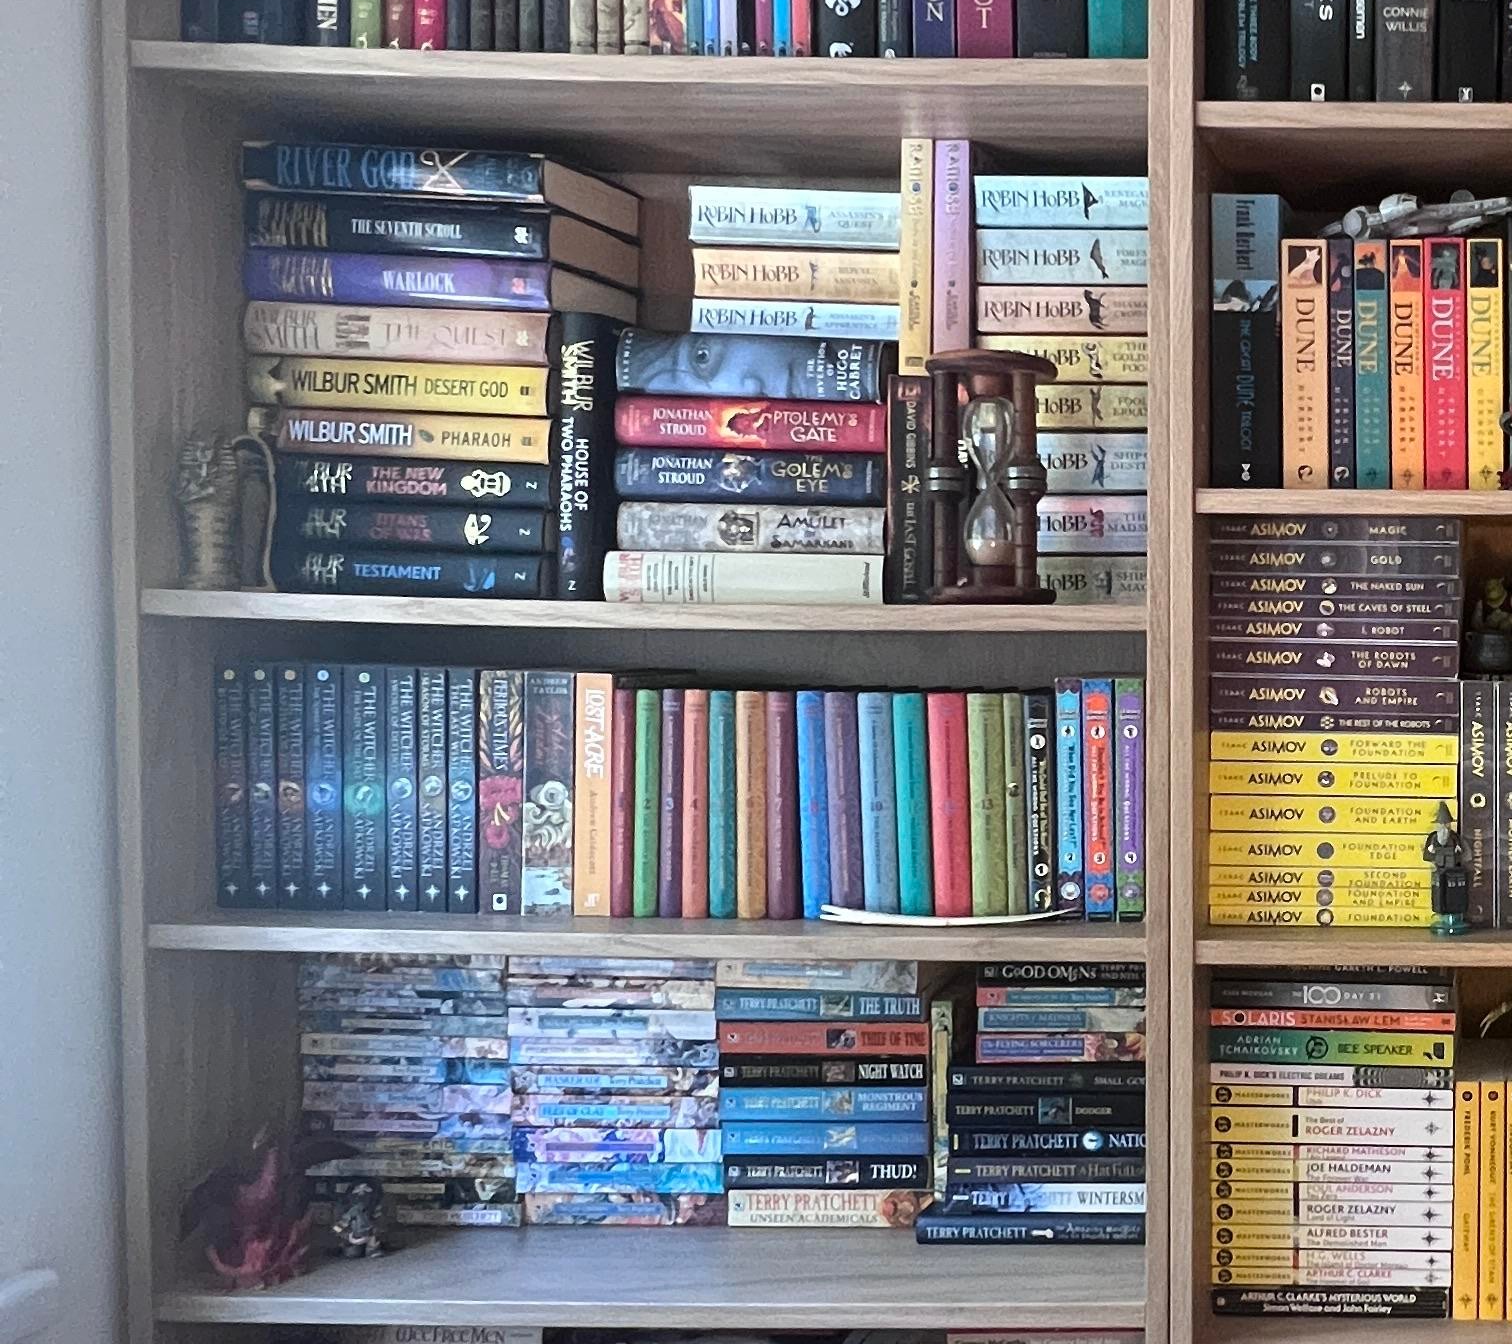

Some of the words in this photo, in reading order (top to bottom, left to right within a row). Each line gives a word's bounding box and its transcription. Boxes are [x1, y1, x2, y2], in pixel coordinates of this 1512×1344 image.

[1383, 7, 1428, 18] CONNIE
[1386, 22, 1427, 33] WILLIS
[277, 148, 352, 189] RIVER
[362, 149, 416, 189] GOD
[382, 270, 454, 293] WARLOCK
[1296, 298, 1314, 373] DUNE
[1432, 298, 1453, 381] DUNE
[837, 350, 848, 390] HUGO
[850, 345, 862, 400] CABRET
[291, 370, 359, 394] WILBUR
[364, 375, 417, 395] SMITH
[424, 378, 475, 395] DESERT
[479, 381, 508, 398] GOD
[790, 427, 838, 442] GATE
[652, 458, 713, 470] JONATHAN
[658, 473, 705, 484] STROUD
[796, 480, 828, 493] EYE
[1251, 523, 1306, 537] ASIMOV
[1370, 526, 1406, 535] MAGIC
[354, 564, 440, 580] TESTAMENT
[1252, 740, 1306, 753] ASIMOV
[1248, 912, 1302, 924] ASIMOV
[1349, 913, 1420, 922] FOUNDATION
[1222, 1011, 1295, 1026] SOLARIS
[1219, 1044, 1297, 1055] TCHAIKOVSKY
[858, 1064, 887, 1078] NIGHT
[890, 1064, 923, 1078] WATCH
[1306, 1127, 1342, 1136] ROGER
[1346, 1127, 1395, 1136] ZELAZNY
[871, 1165, 917, 1179] THUD!
[747, 1196, 790, 1211] TERRY
[794, 1195, 878, 1211] PRATCHETT
